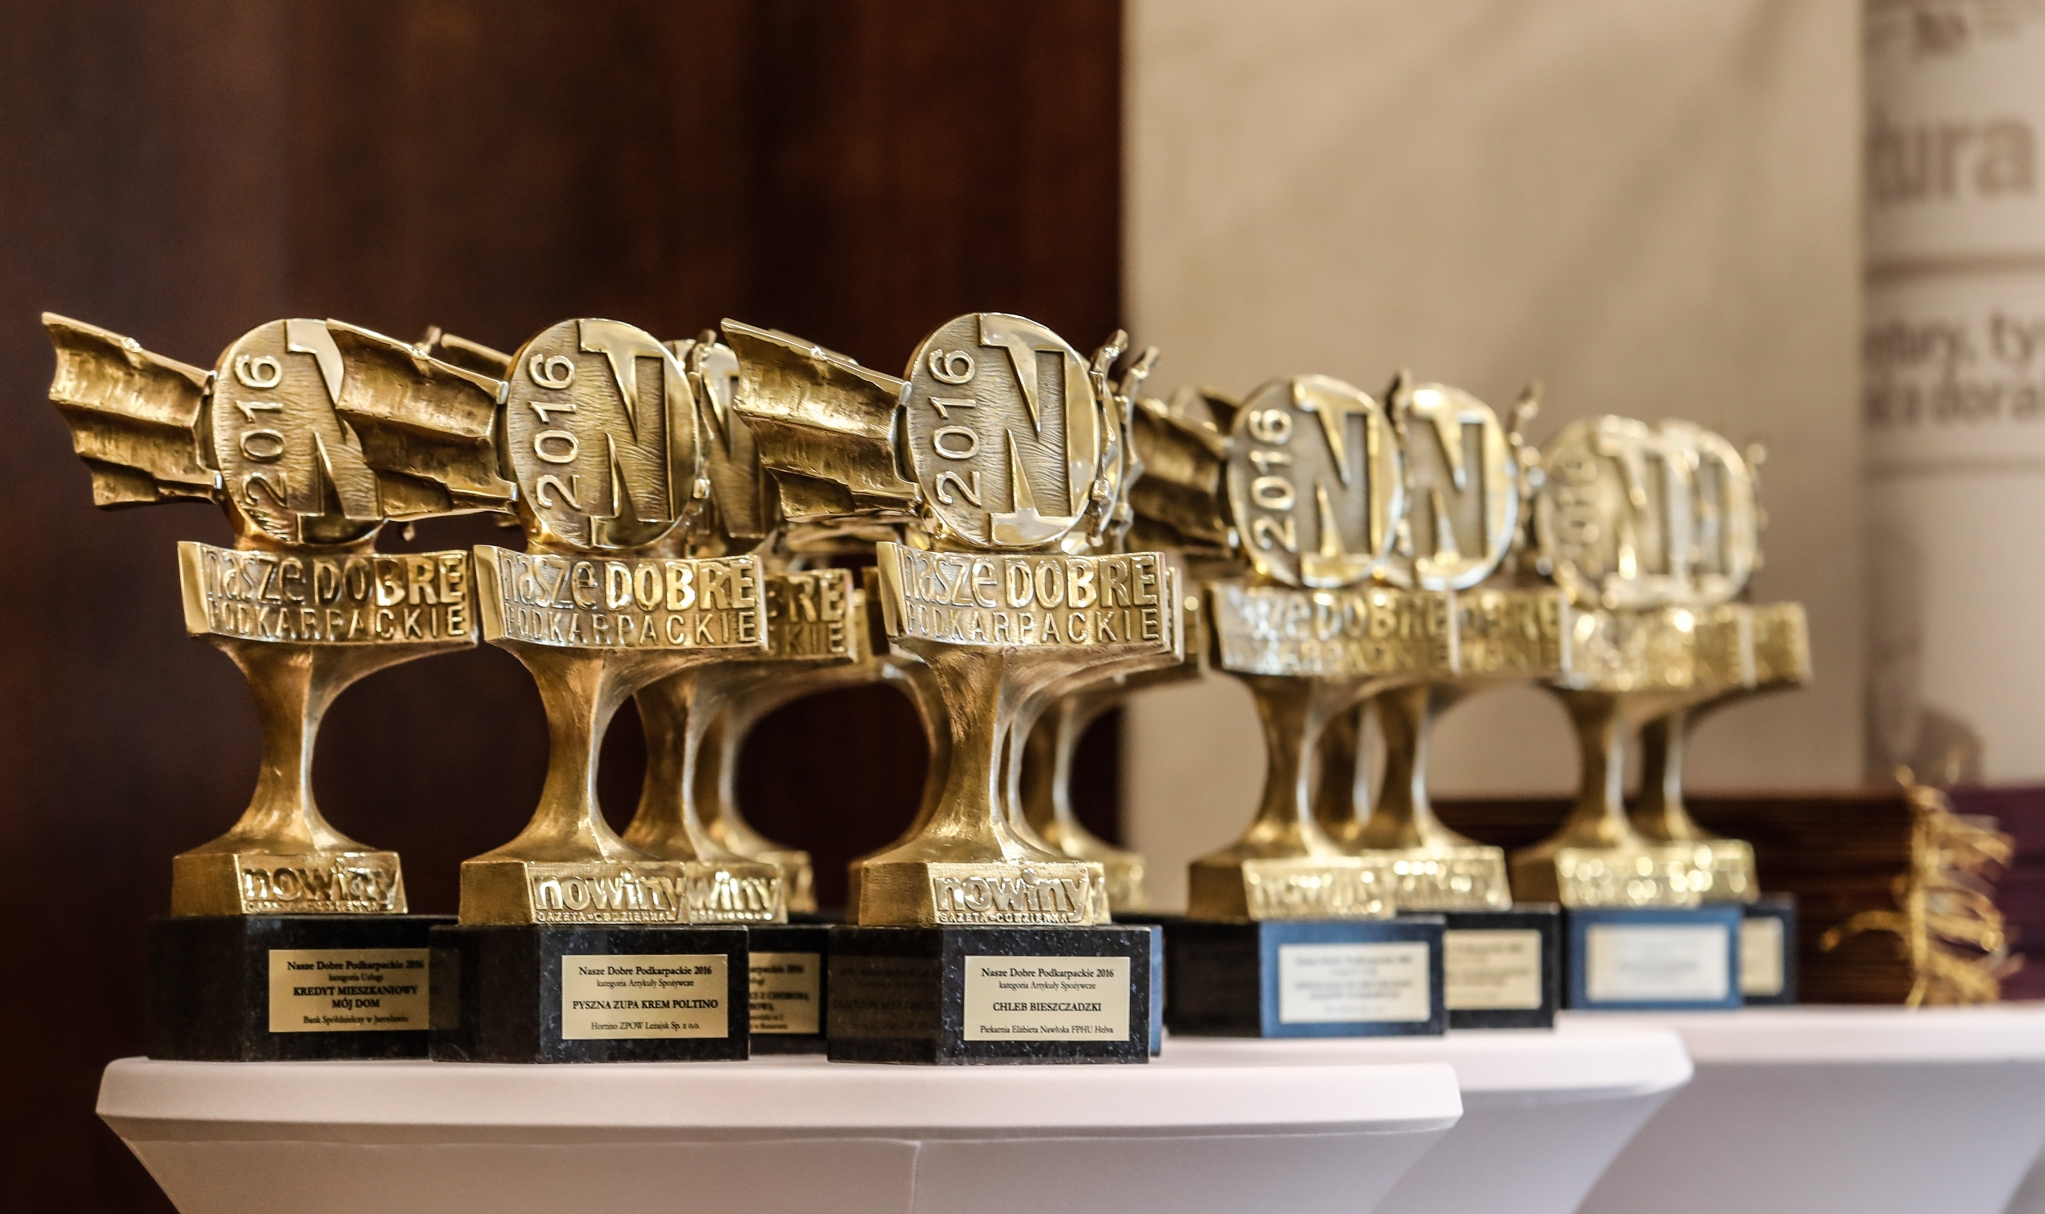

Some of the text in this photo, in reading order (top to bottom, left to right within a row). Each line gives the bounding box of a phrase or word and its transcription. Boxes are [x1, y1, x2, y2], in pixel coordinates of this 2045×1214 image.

[234, 354, 288, 509] 2016
[528, 353, 582, 509] 2016
[577, 317, 699, 549] N
[928, 348, 982, 507] 2016
[979, 312, 1100, 545] N
[1250, 408, 1297, 551] 2016
[202, 549, 468, 606] nasze DOBRE
[500, 549, 756, 611] nasze DOBRE
[902, 549, 1158, 609] nasze DOBRE
[207, 598, 467, 640] PODKARPACKIE
[504, 602, 758, 646] PODKARPACKIE
[905, 600, 1160, 643] PODKARPACKIE
[243, 857, 399, 911] nowiny
[532, 867, 686, 920] nowiny
[934, 867, 1089, 923] nowiny
[287, 961, 314, 970] Nasze
[316, 961, 343, 970] Dobre
[345, 960, 403, 972] Podkarpackie
[579, 965, 712, 977] Nasze Dobre Podkarpackie 2016
[597, 979, 695, 989] kategoria Artykuły Spożywcze
[981, 967, 1115, 980] Nasze Dobre Podkarpackie 2016
[999, 980, 1096, 991] kategoria Artykuły Spożywcze
[293, 985, 418, 996] KREDYT MIESZKANIOWY
[332, 998, 380, 1010] MÓJ DOM
[572, 999, 718, 1010] PYSZNA ZUPA KREM POLTINO
[992, 1002, 1102, 1012] CHLEB BIESZCZADZKI
[303, 1016, 321, 1024] Bank
[591, 1022, 618, 1030] Hortino
[619, 1021, 643, 1030] ZPOW
[980, 1024, 1010, 1034] Piekarnia
[1071, 1025, 1093, 1034] FPHU
[1094, 1025, 1114, 1034] Helva
